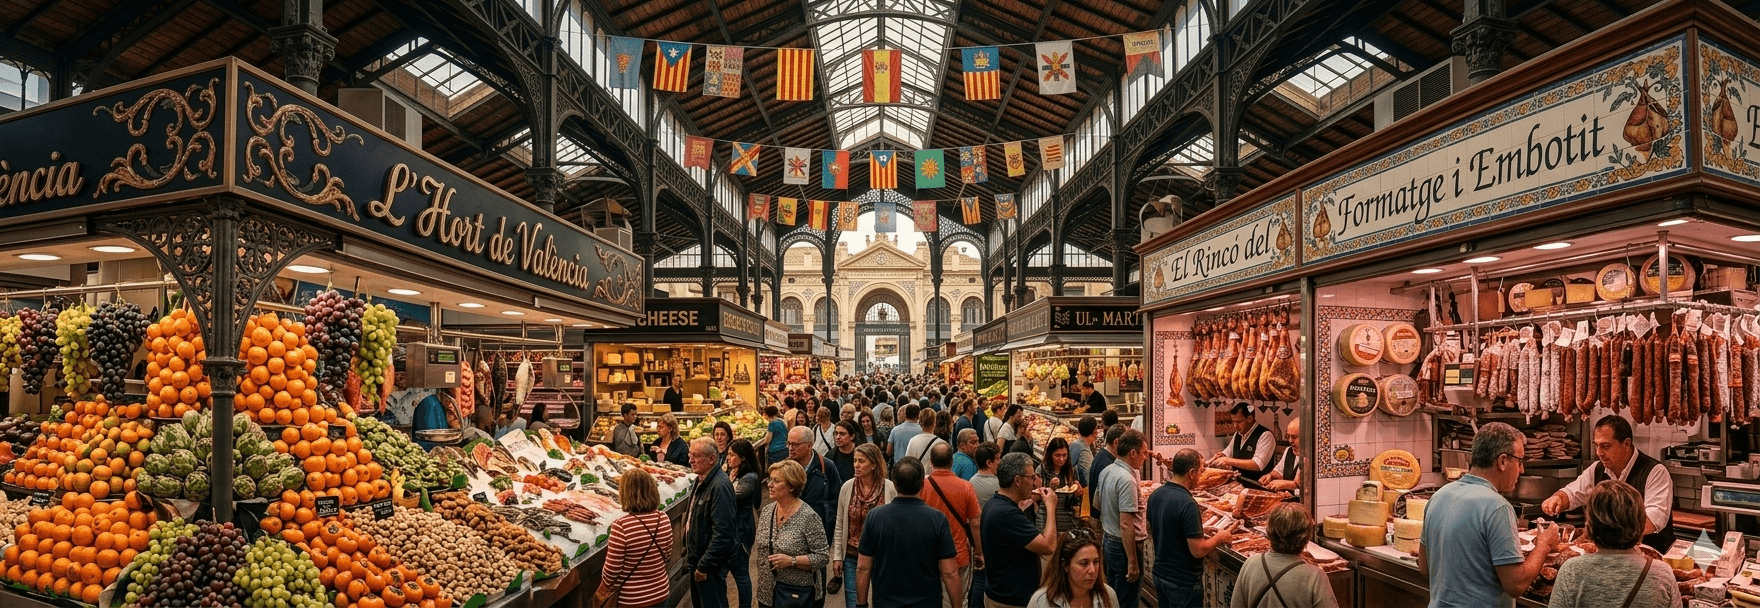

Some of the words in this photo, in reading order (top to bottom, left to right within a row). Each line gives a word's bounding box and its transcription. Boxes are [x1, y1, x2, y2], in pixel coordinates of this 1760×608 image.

[1338, 174, 1446, 236] Formatge
[1452, 157, 1464, 199] i
[1469, 114, 1605, 192] Embotit
[368, 163, 485, 254] L'Hort
[490, 216, 515, 265] de
[516, 221, 590, 290] València
[1171, 250, 1191, 282] El
[1192, 235, 1239, 278] Rincó
[1244, 218, 1274, 260] del
[1102, 311, 1144, 327] MART
